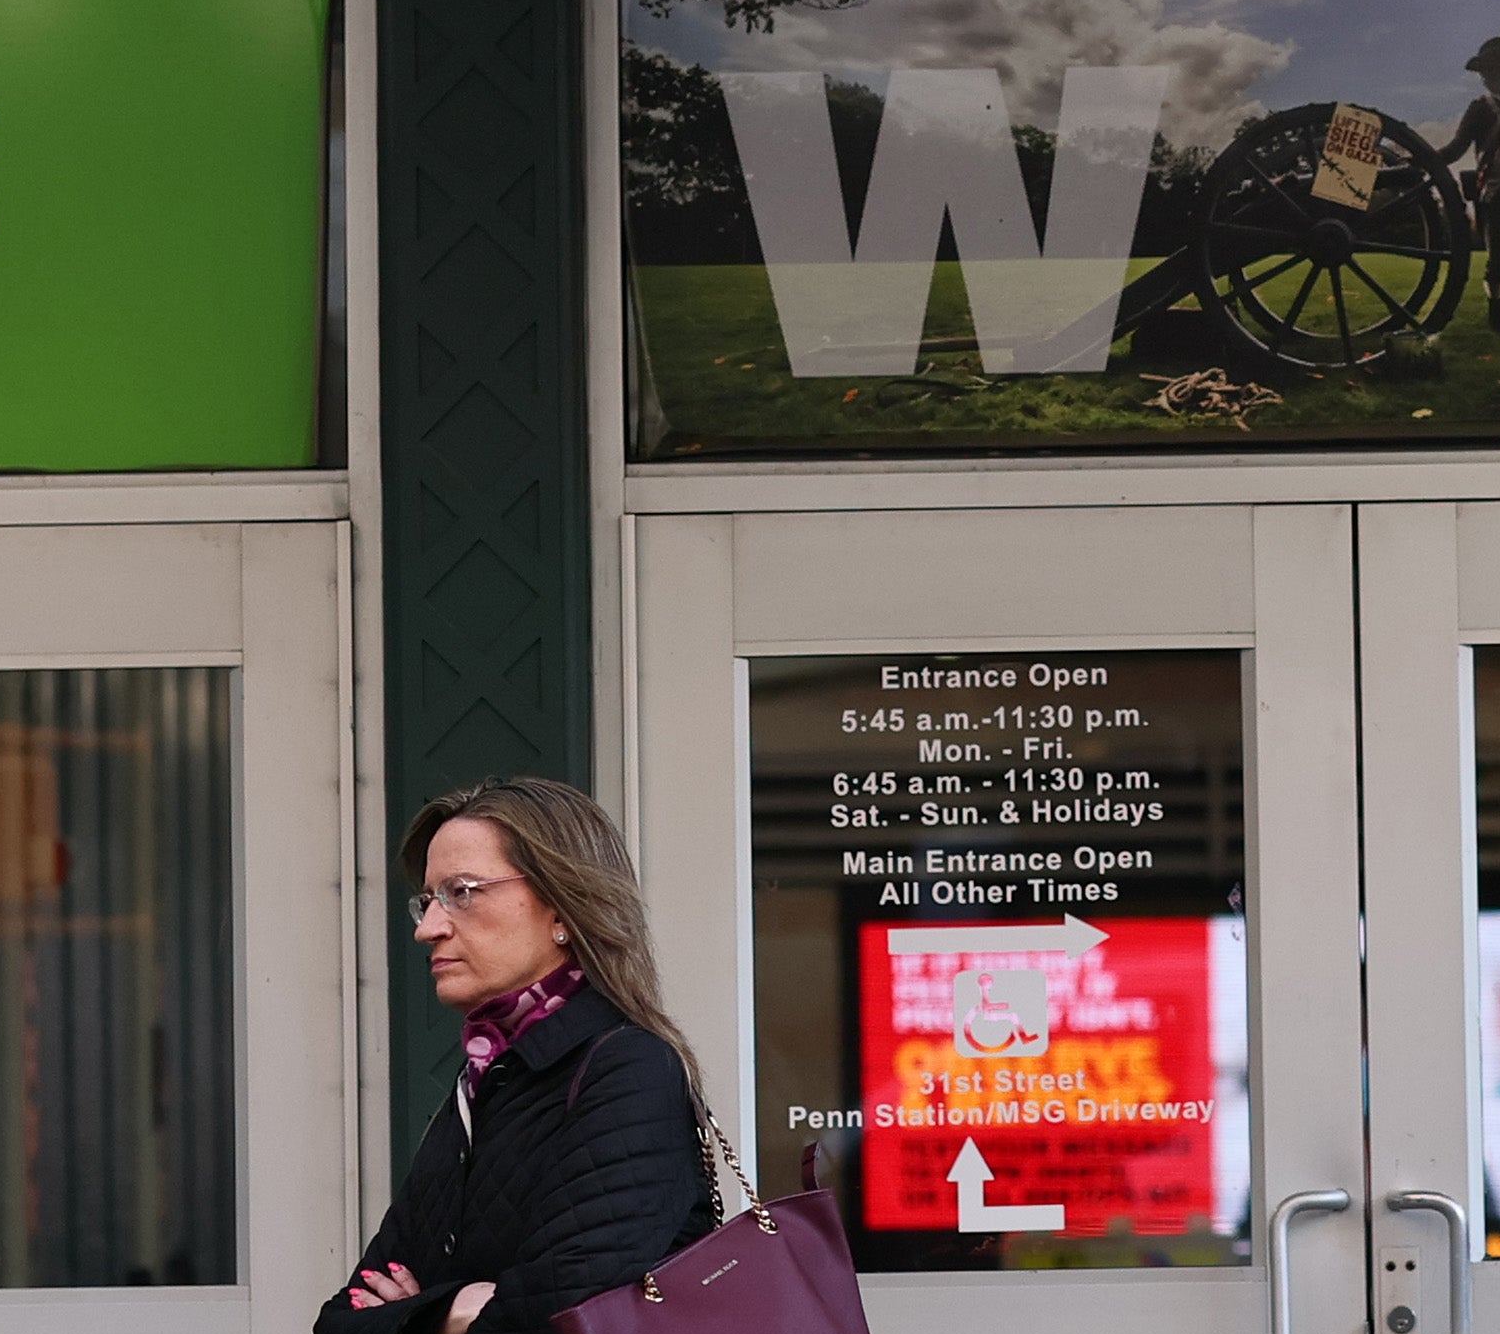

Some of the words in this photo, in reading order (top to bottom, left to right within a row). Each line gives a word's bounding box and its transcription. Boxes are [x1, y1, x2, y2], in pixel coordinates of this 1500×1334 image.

[1346, 148, 1377, 164] GAZA
[882, 666, 1017, 689] Entrance
[1029, 663, 1107, 691] Open
[842, 708, 905, 733] 5:45
[916, 705, 1073, 731] a.m.-11:30
[1086, 709, 1149, 733] p.m.
[919, 739, 991, 763] Mon.
[1024, 736, 1073, 760] Fri.
[833, 772, 897, 796] 6:45
[908, 776, 971, 794] a.m.
[1004, 767, 1084, 792] 11:30
[1096, 771, 1160, 796] p.m.
[831, 804, 888, 828] Sat.
[921, 802, 988, 826] Sun.
[999, 800, 1020, 824] &
[1032, 798, 1164, 827] Holidays
[843, 851, 913, 875] Main
[926, 849, 1062, 873] Entrance
[1074, 846, 1153, 875] Open
[879, 881, 919, 905] All
[932, 880, 1017, 905] Other
[1027, 878, 1118, 902] Times
[919, 1068, 983, 1095] 31st
[991, 1068, 1086, 1095] Street
[787, 1103, 863, 1130] Penn
[875, 1099, 1066, 1130] Station/MSG
[1077, 1096, 1214, 1130] Driveway
